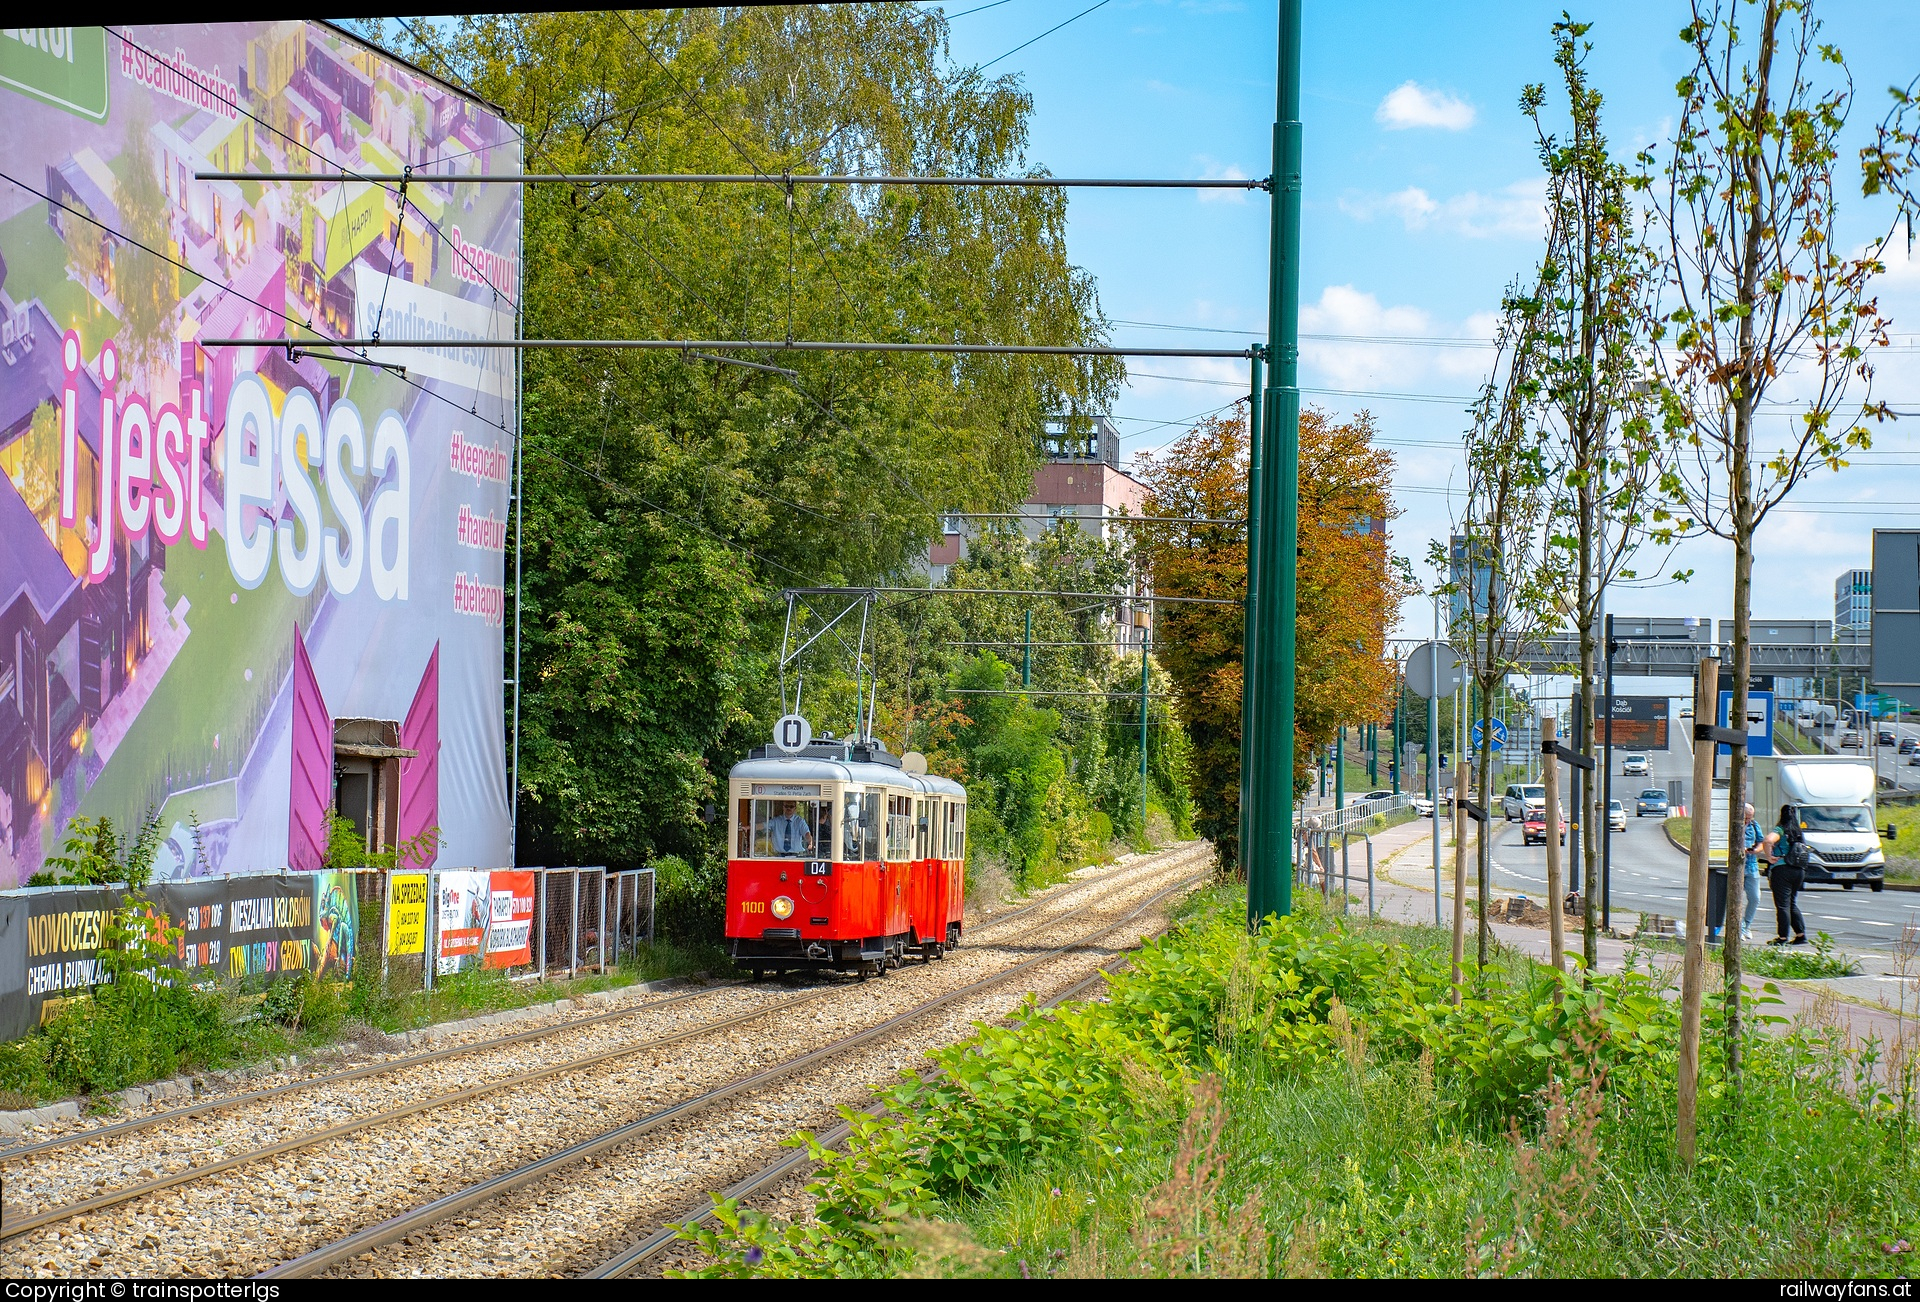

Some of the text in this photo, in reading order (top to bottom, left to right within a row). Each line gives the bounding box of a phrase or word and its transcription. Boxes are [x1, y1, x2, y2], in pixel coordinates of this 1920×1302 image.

[121, 28, 237, 121] #scandimarine
[351, 205, 373, 239] HAPPY
[452, 226, 515, 309] Rezerwuj
[61, 330, 411, 601] i jest essa
[450, 433, 508, 485] #keepcalm
[455, 574, 504, 623] #behappy
[811, 863, 826, 875] 04
[229, 889, 311, 933] MIESZALNIA KOLORÓW
[392, 883, 401, 905] NA
[741, 901, 765, 914] 1100
[252, 941, 278, 975] FARBY
[280, 938, 311, 972] GRUNTY
